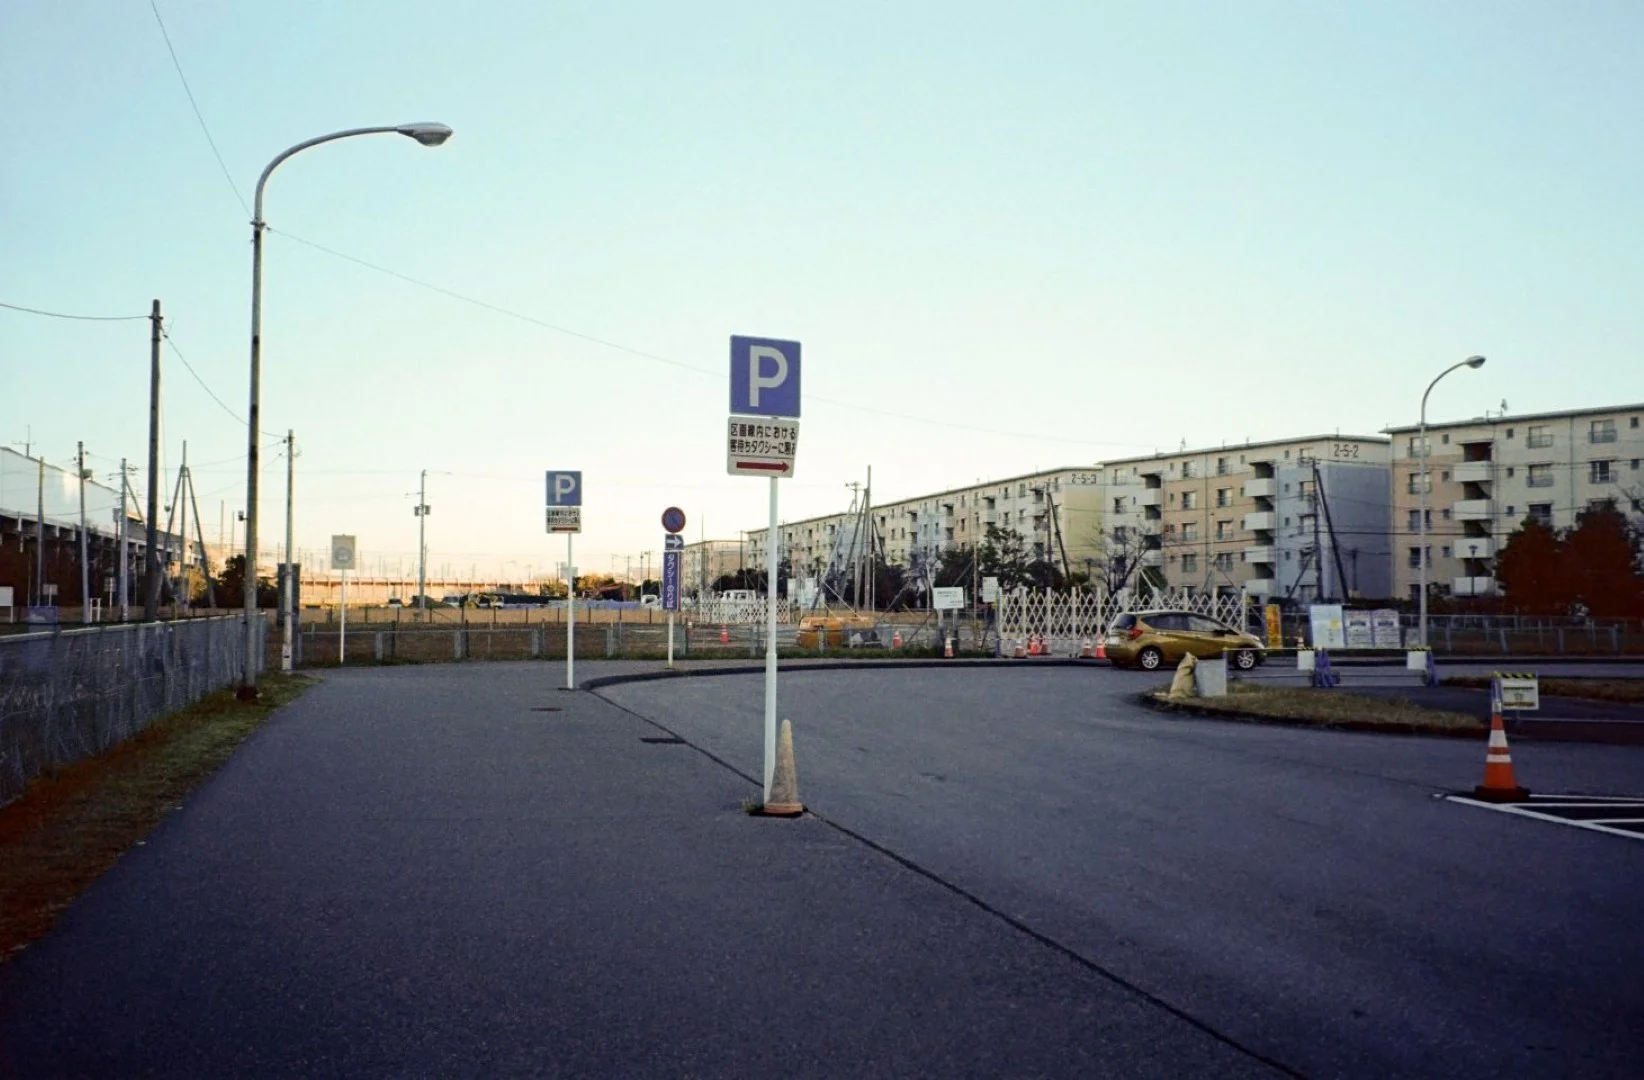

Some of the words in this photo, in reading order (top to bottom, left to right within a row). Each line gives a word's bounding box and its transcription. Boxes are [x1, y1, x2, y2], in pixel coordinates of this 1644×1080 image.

[749, 345, 788, 407] P
[1333, 444, 1359, 458] 2-5-2
[555, 474, 576, 503] P
[1071, 473, 1097, 485] 2-5-3
